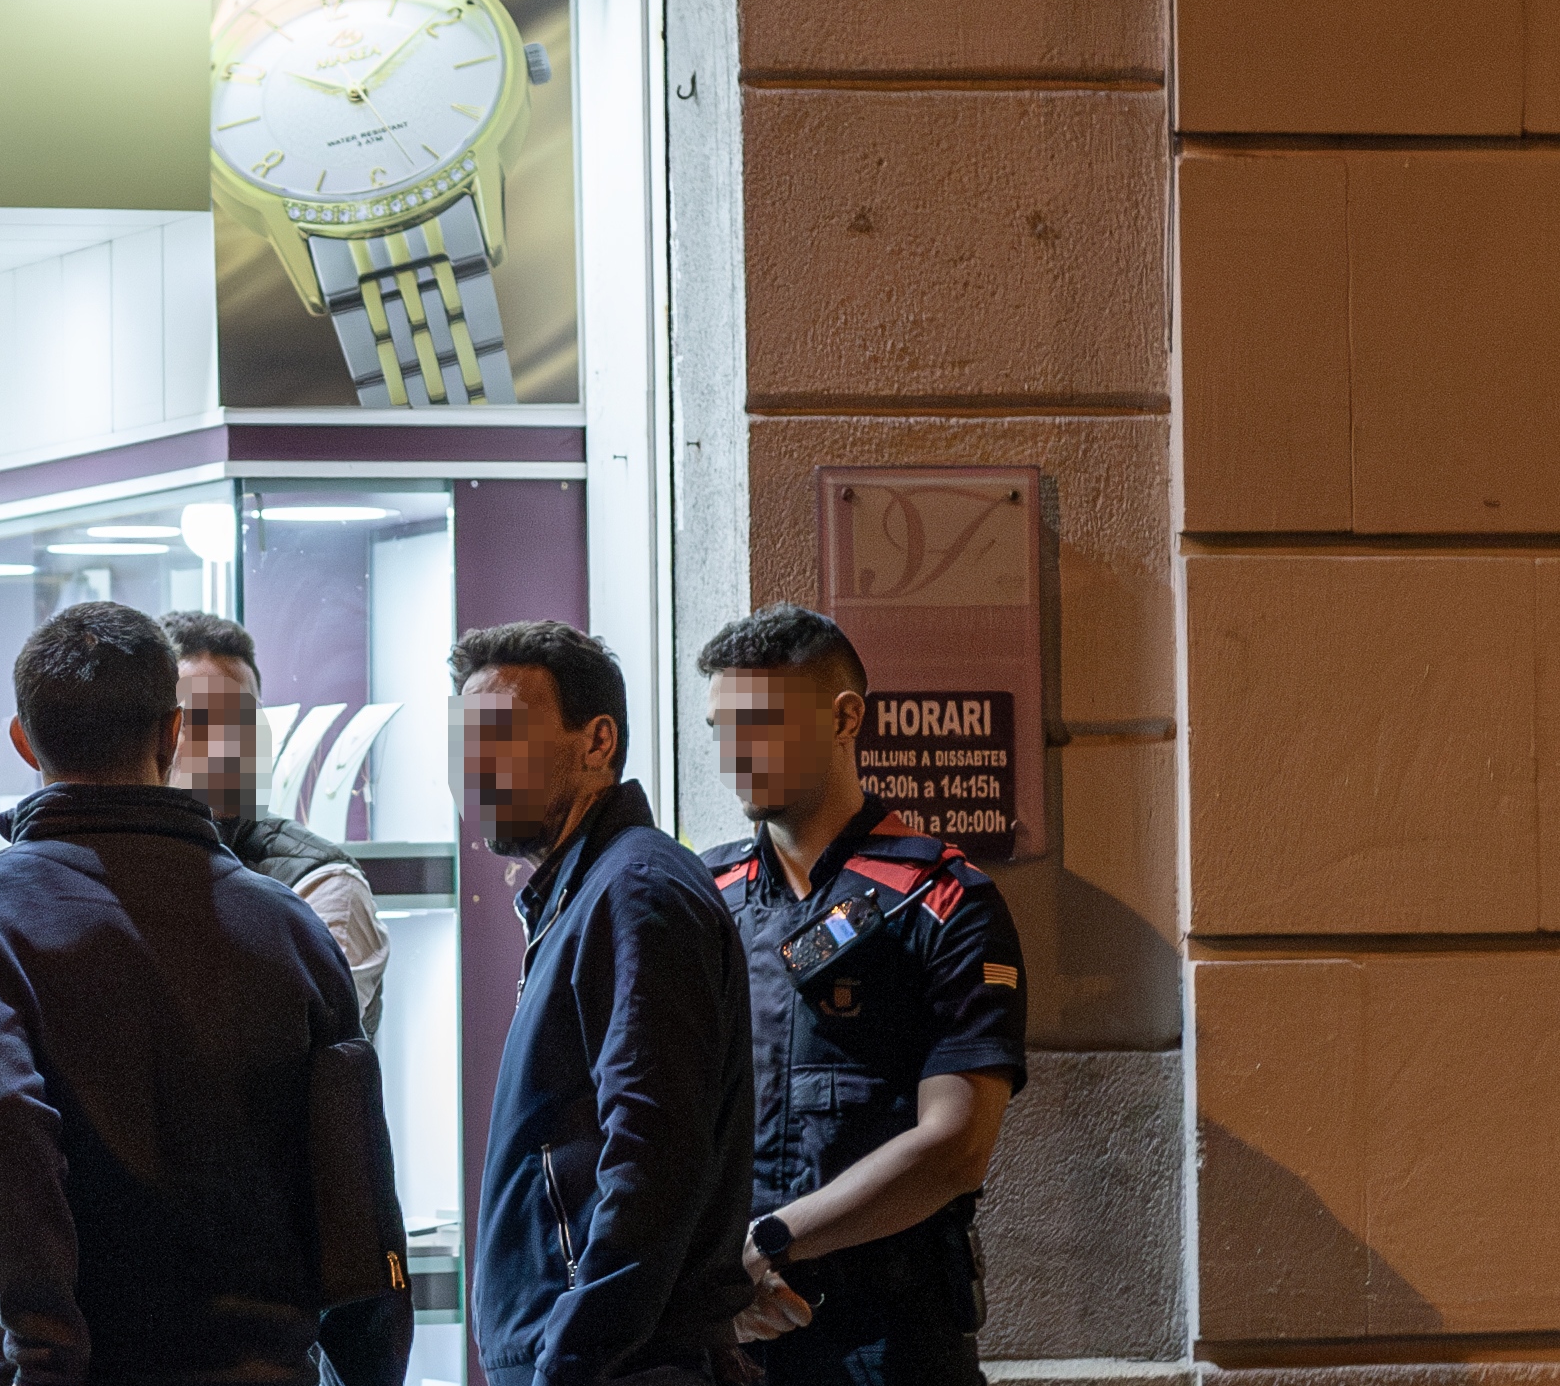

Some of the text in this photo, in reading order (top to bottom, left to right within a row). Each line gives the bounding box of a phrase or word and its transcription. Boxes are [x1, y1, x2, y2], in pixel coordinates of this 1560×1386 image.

[878, 699, 991, 737] HORARI
[860, 750, 1007, 768] DILLUNS A DISSABTES
[860, 775, 1000, 799] 10:30h a 14:15h
[930, 815, 941, 833] a
[946, 809, 1006, 833] 20:00h
